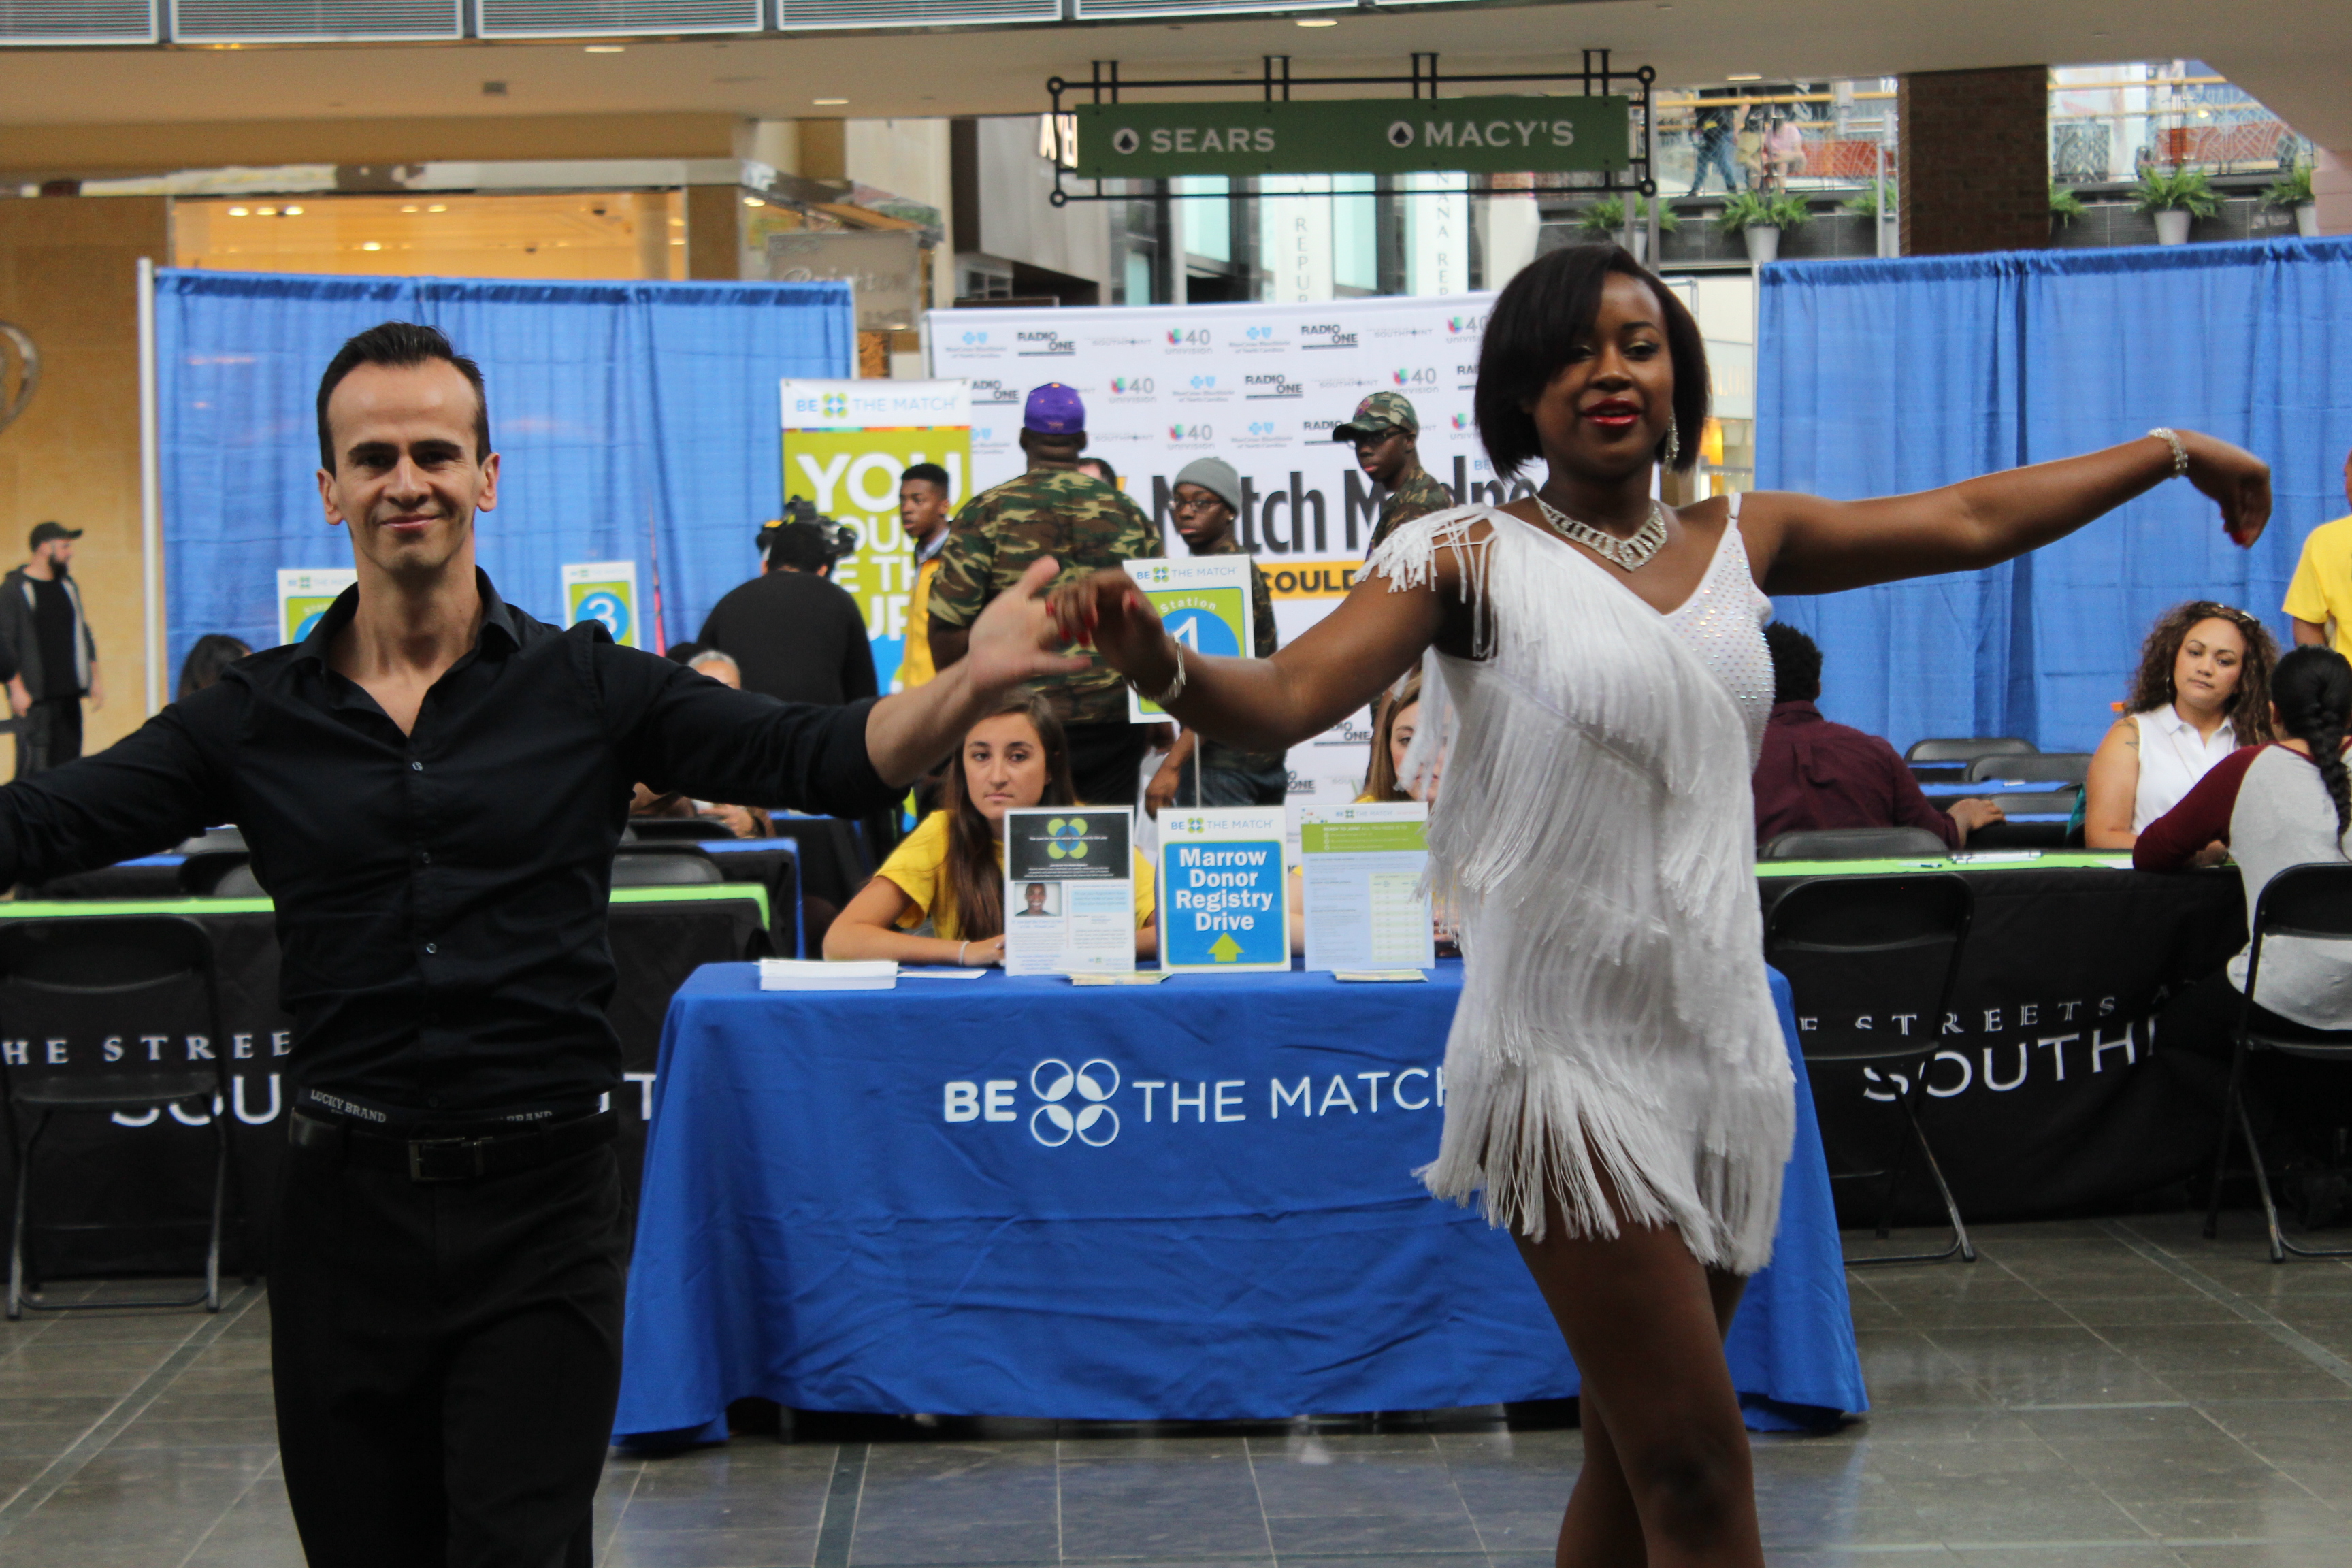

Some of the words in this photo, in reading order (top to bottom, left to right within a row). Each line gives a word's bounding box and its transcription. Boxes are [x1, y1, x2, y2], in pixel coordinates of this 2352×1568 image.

[1150, 127, 1276, 154] SEARS
[1424, 120, 1575, 148] MACY'S
[1018, 331, 1058, 342] RADIO
[1186, 329, 1211, 346] 40
[1301, 325, 1341, 335] RADIO
[1049, 341, 1076, 351] ONE
[1331, 333, 1358, 344] ONE
[1446, 336, 1482, 344] univisi
[1245, 374, 1285, 385] RADIO
[1411, 368, 1437, 384] 40
[971, 380, 1002, 390] ADIO
[1129, 378, 1155, 393] 40
[1276, 384, 1303, 395] ONE
[994, 390, 1020, 400] ONE
[796, 399, 818, 412] BE
[853, 398, 885, 412] THE
[893, 395, 954, 412] MATCH
[1187, 424, 1213, 440] 40
[1303, 420, 1343, 431] RADIO
[1152, 470, 1326, 554] Mtch
[870, 554, 916, 593] TH
[1137, 570, 1151, 580] BE
[1171, 569, 1193, 578] THE
[1197, 567, 1234, 576] MATCH
[1160, 597, 1217, 613] Station
[587, 598, 618, 635] 3
[1344, 730, 1371, 742] ONE
[1288, 780, 1316, 790] ONE
[1171, 821, 1185, 830] BE
[1207, 821, 1228, 829] THE
[1232, 819, 1272, 829] MATCH
[1179, 848, 1267, 867] Marrow
[1190, 869, 1258, 887] Donor
[1175, 889, 1273, 913] Registry
[1196, 912, 1255, 931] Drive
[103, 1030, 292, 1062] STREE
[944, 1081, 1018, 1122] BE
[1132, 1079, 1247, 1123] THE
[1271, 1066, 1447, 1118] MATC
[310, 1089, 344, 1109] LUCKY
[344, 1101, 387, 1123] BRAND
